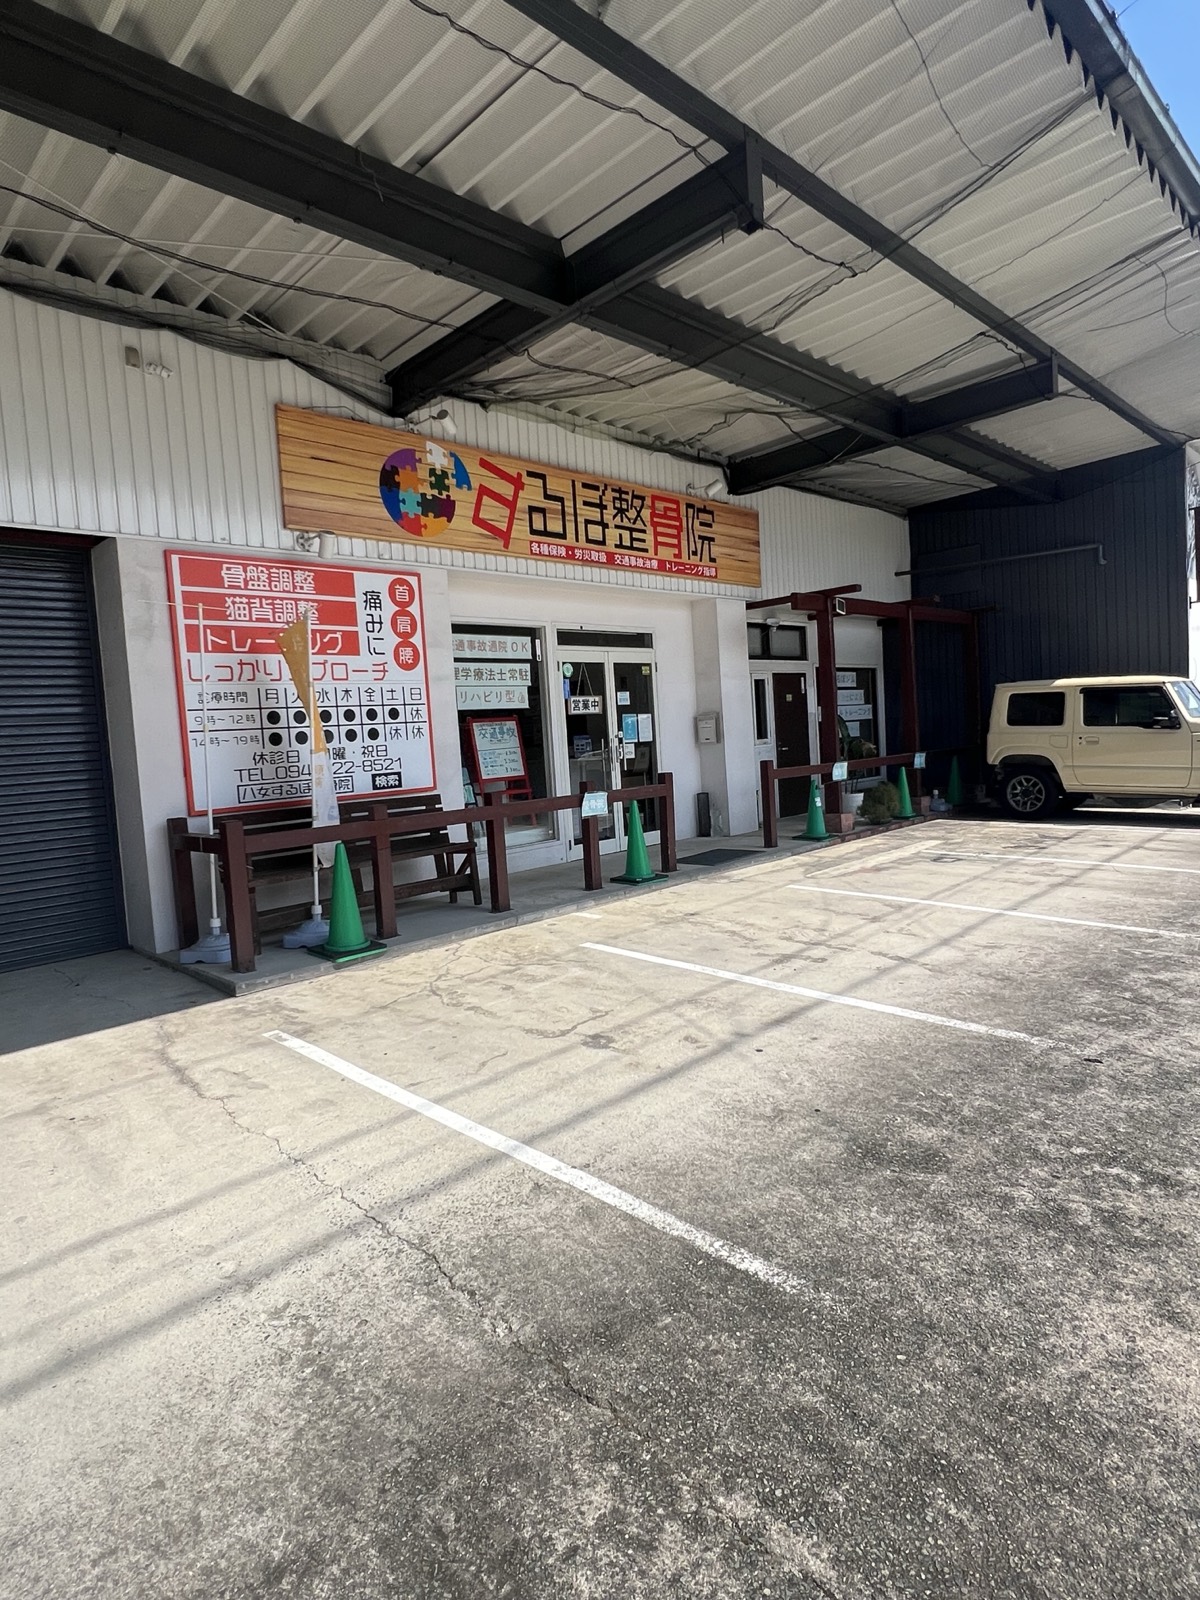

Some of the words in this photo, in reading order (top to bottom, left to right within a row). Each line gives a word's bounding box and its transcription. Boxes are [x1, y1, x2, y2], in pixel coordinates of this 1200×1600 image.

[472, 457, 717, 563] するぼ整骨院
[530, 542, 607, 563] 各種保険・労災取扱
[614, 555, 659, 570] 交通事故治療
[665, 562, 717, 577] トレーニング指導
[220, 564, 317, 594] 骨盤調整
[394, 584, 410, 601] 首
[225, 597, 320, 625] 猫背調整
[362, 590, 386, 655] 痛みに
[396, 616, 412, 634] 肩
[206, 629, 342, 653] トレーング
[399, 647, 414, 664] 腰
[187, 659, 389, 681] しっかりプローチ
[265, 689, 279, 703] 月
[317, 689, 331, 703] 水
[340, 688, 353, 702] 木
[364, 687, 377, 702] 金
[386, 688, 399, 701] 土
[410, 687, 422, 701] 日
[572, 698, 599, 711] 営業中
[410, 707, 422, 721] 休
[389, 726, 402, 740] 休
[411, 725, 424, 739] 休
[252, 750, 300, 766] 休診日
[374, 775, 399, 788] 検索
